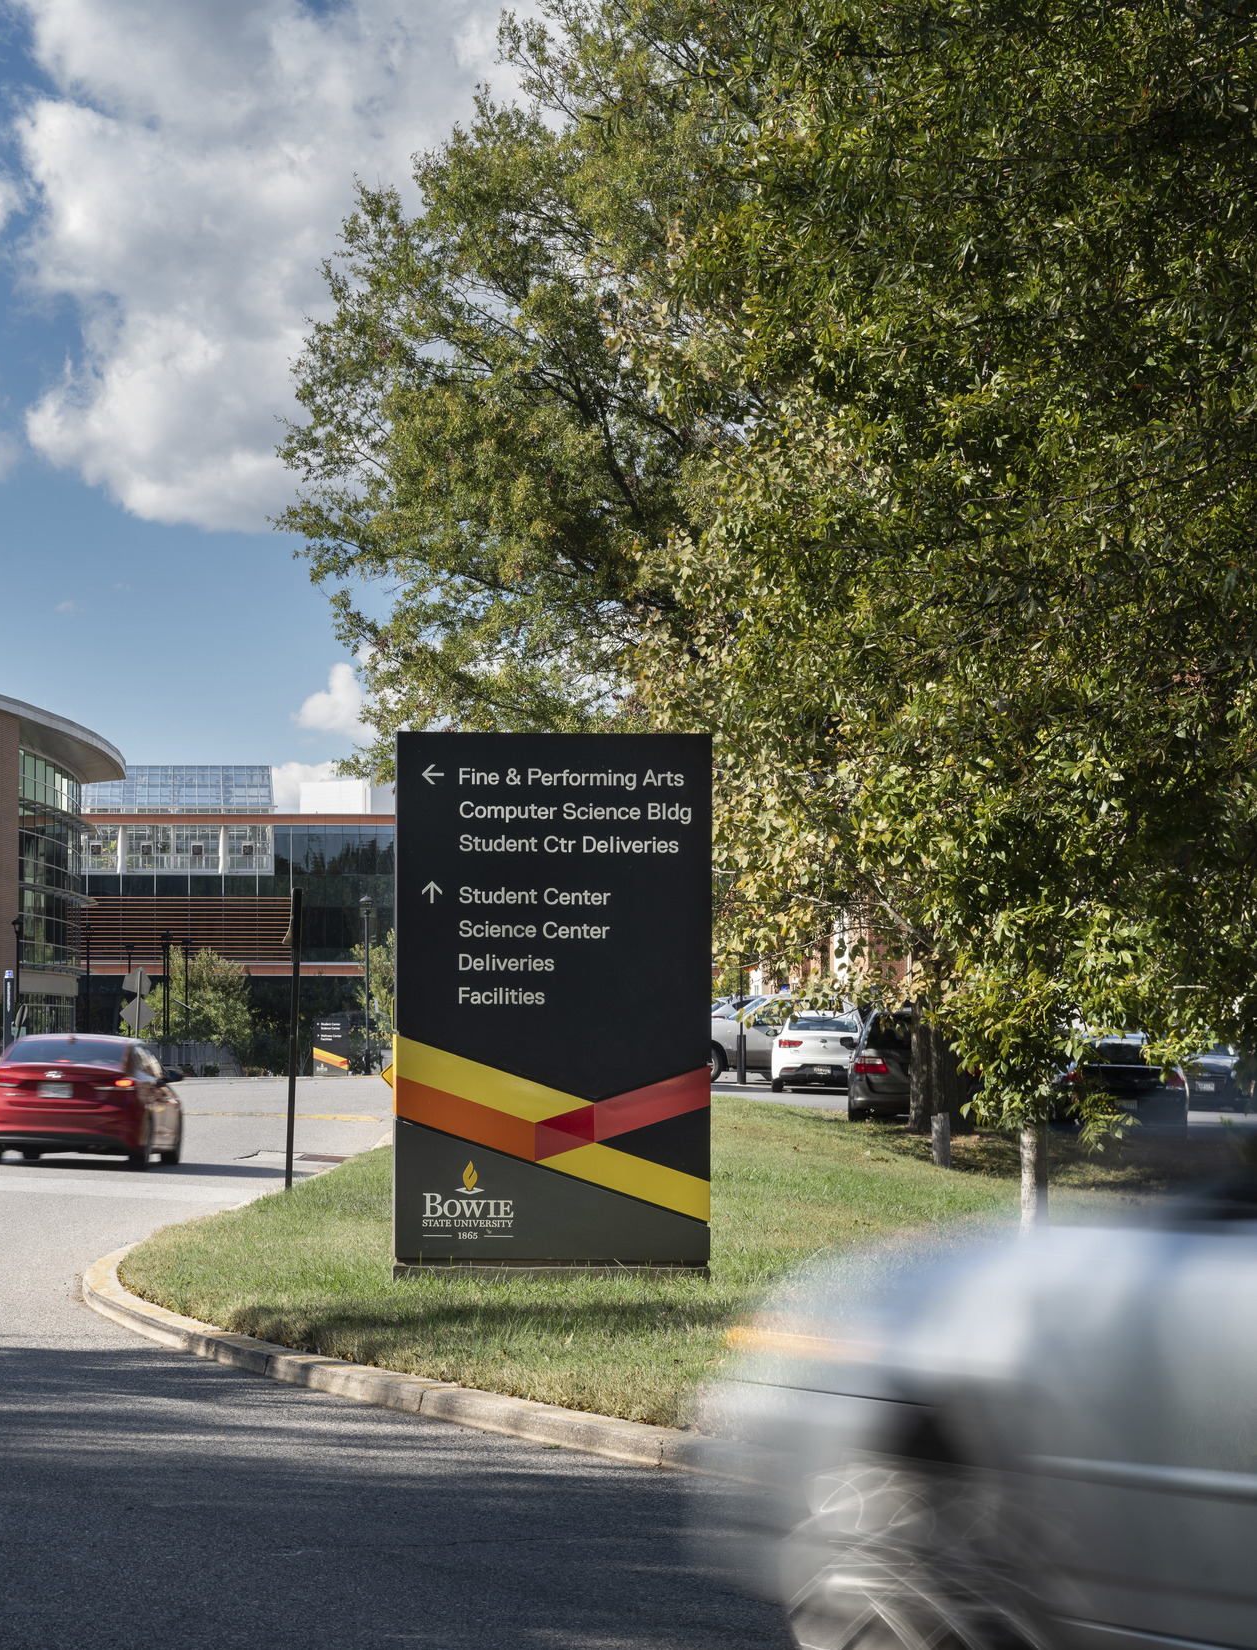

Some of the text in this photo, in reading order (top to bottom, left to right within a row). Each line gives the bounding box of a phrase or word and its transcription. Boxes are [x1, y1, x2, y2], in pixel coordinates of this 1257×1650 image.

[458, 767, 685, 791] Fine & Performing Arts
[458, 801, 692, 825] Computer Science Bldg
[458, 834, 680, 854] Student Ctr Deliveries
[458, 887, 612, 906] Student Center
[458, 920, 611, 940] Science Center
[458, 953, 555, 972] Deliveries
[458, 986, 546, 1005] Facilities
[422, 1193, 514, 1218] BOWIE
[422, 1219, 514, 1229] STATE UNIVERSITY
[457, 1231, 479, 1240] 1865
